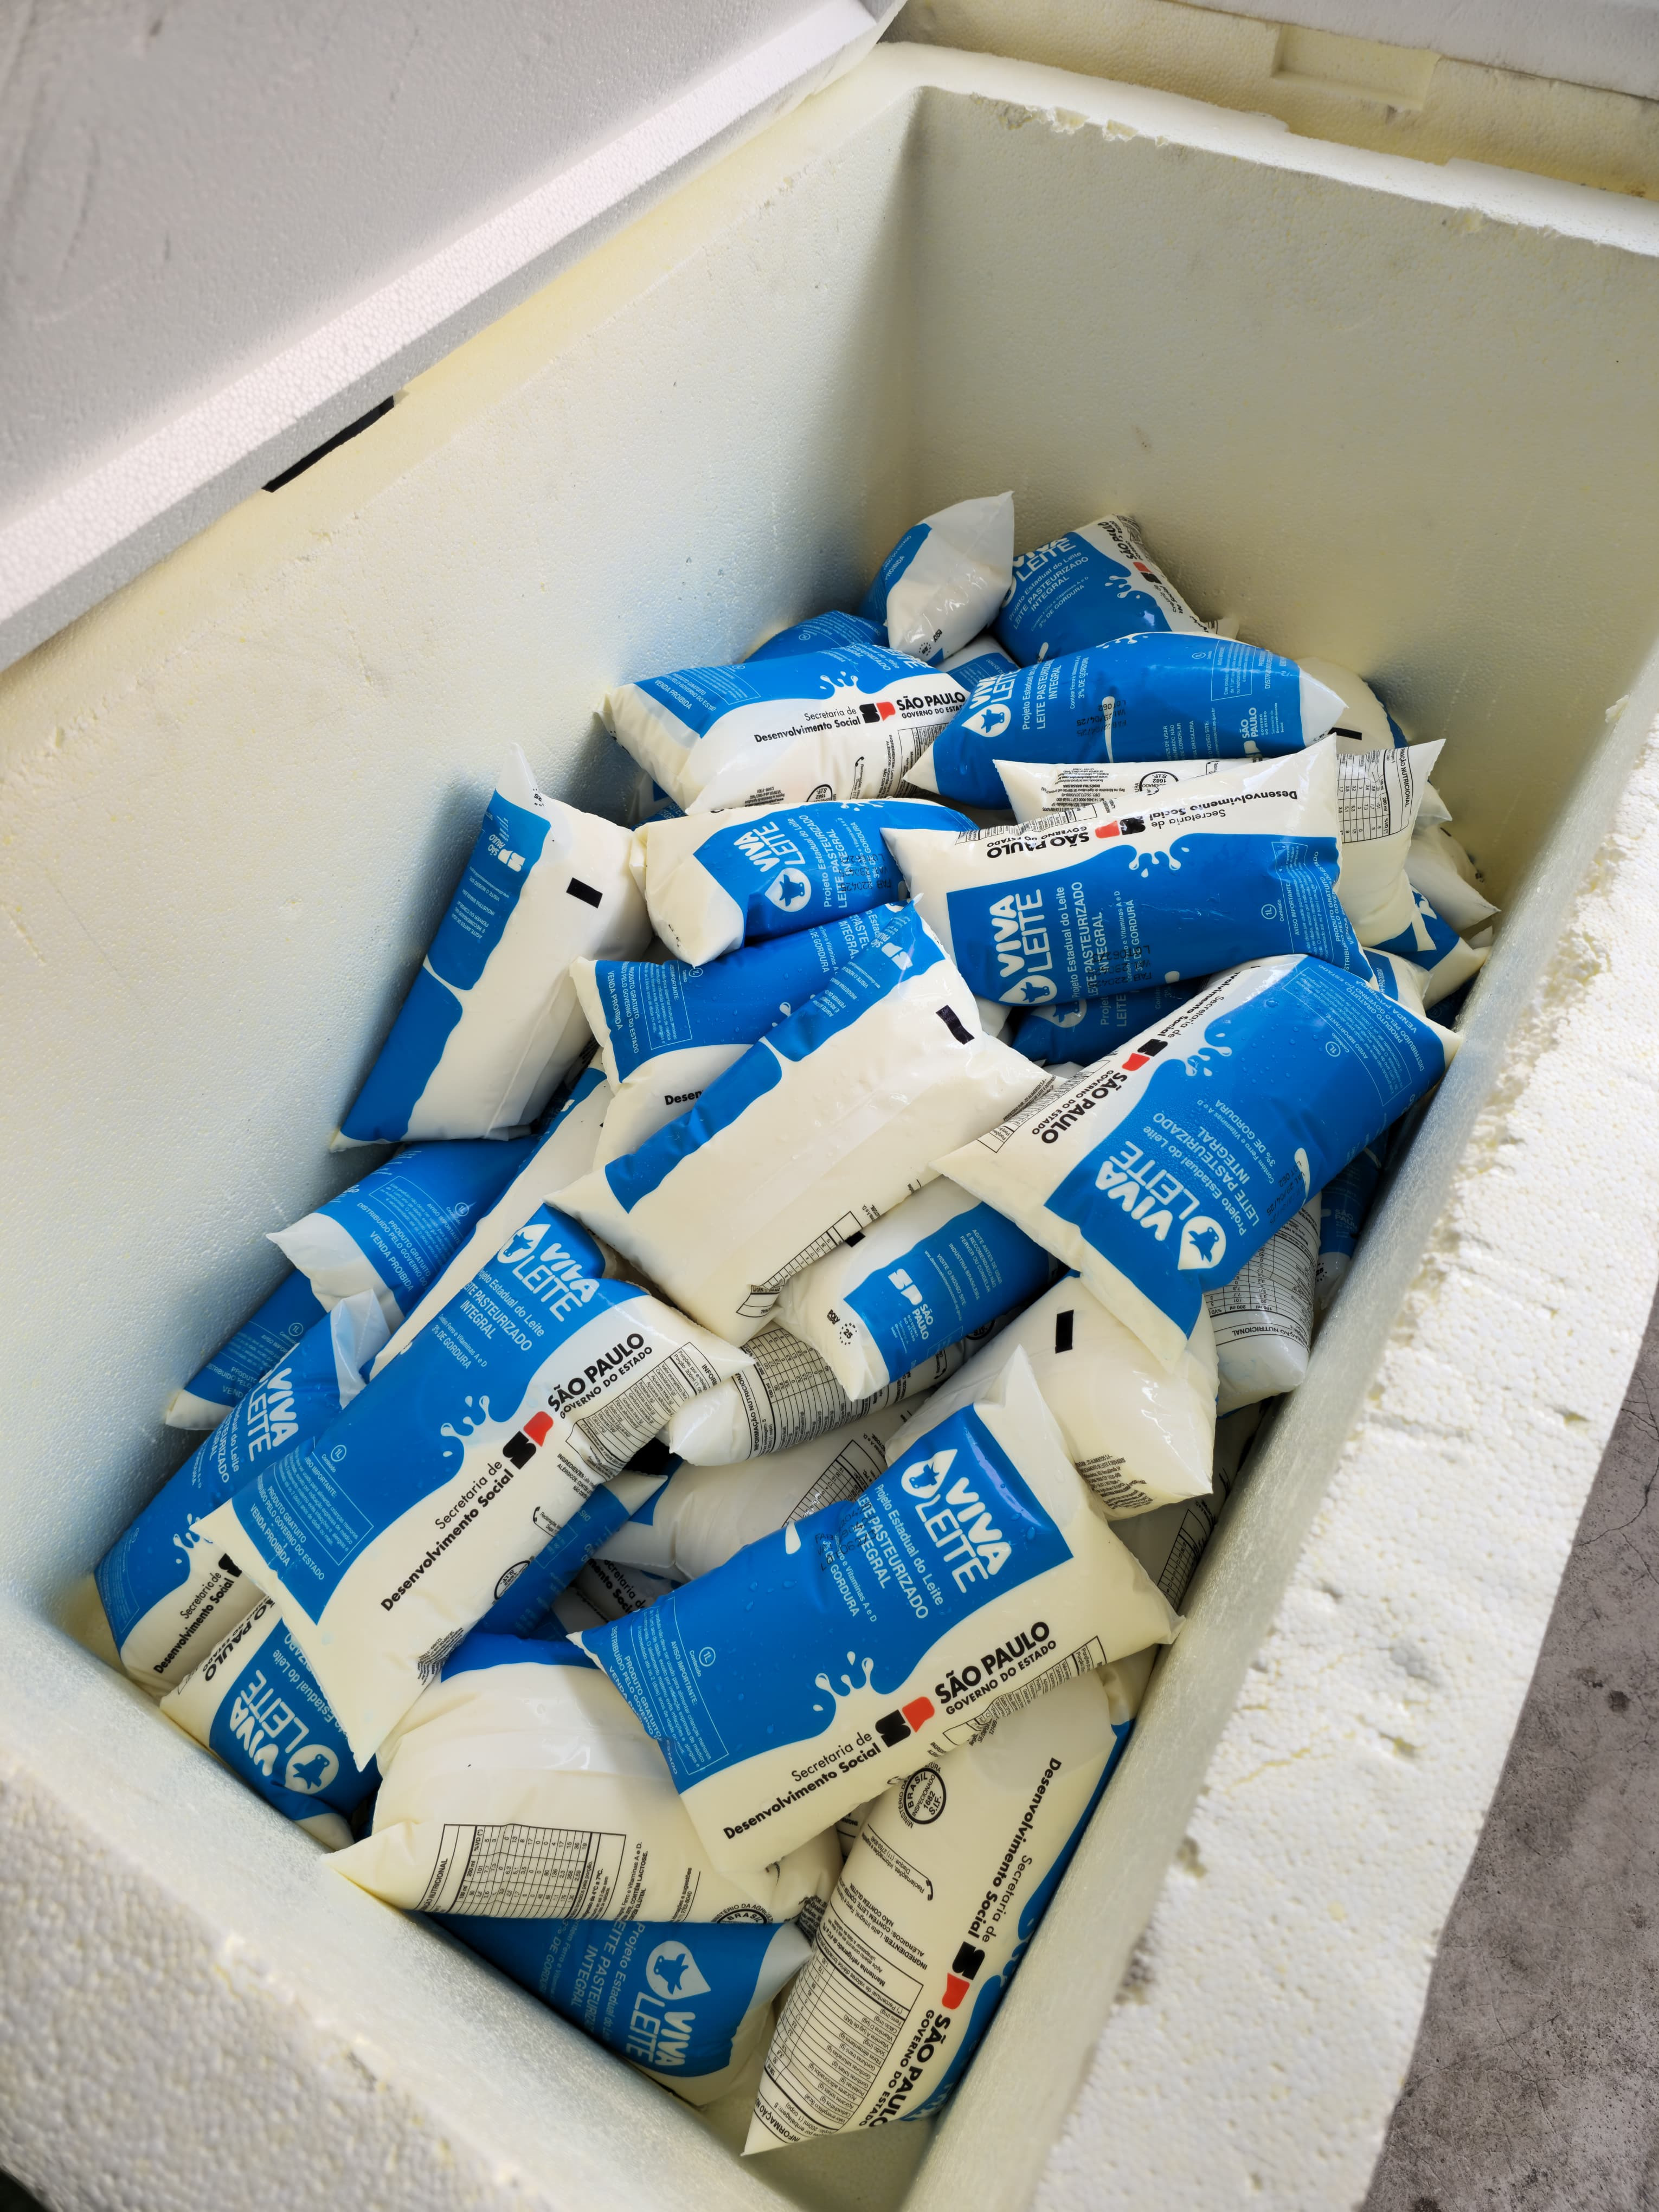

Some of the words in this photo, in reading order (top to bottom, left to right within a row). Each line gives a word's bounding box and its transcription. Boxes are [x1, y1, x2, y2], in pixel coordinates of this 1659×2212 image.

[1015, 540, 1076, 582] LEITE
[1025, 567, 1053, 596] Estadual
[1028, 556, 1089, 606] PASTEURIZADO
[1031, 576, 1070, 612] INTEGRAL
[670, 689, 693, 710] PROIBIDA
[896, 695, 923, 711] SÃO
[927, 692, 965, 707] PAULO
[1048, 665, 1062, 700] INTEGRAL
[754, 723, 832, 743] Desenvolvimento
[834, 717, 861, 729] Social
[804, 709, 844, 722] Secretaria
[846, 707, 857, 715] de
[901, 710, 933, 719] GOVERNO
[1023, 700, 1031, 730] Projeto
[1036, 700, 1046, 730] LEITE
[1239, 719, 1249, 738] SÃO
[1249, 707, 1259, 738] PAULO
[1189, 790, 1297, 812] Desenvolvimento
[1400, 766, 1410, 808] NUTRICIONAL
[1151, 820, 1165, 829] de
[1168, 809, 1226, 826] Secretaria
[487, 844, 499, 857] SÃO
[488, 833, 506, 850] PAULO
[734, 831, 780, 872] VIVA
[752, 821, 806, 865] LEITE
[799, 815, 841, 875] PASTEURIZADO
[806, 837, 826, 870] Estadual
[1050, 832, 1090, 848] SÃO
[822, 872, 832, 908] Projeto
[1056, 886, 1068, 910] Leite
[989, 895, 1025, 978] VIVA
[1015, 889, 1053, 973] LEITE
[1061, 912, 1070, 926] do
[1071, 882, 1096, 969] PASTEURIZADO
[1126, 899, 1140, 946] GORDURA
[813, 937, 831, 974] GORDURA
[1064, 927, 1077, 973] Estadual
[629, 988, 640, 1020] GRATUITO
[1071, 974, 1081, 998] Projeto
[1346, 988, 1378, 1015] GRATUITO
[610, 994, 623, 1031] PROIBIDA
[1157, 1015, 1188, 1037] Social
[1180, 996, 1225, 1028] Secretaria
[1376, 1013, 1403, 1044] PRODUTO
[1392, 1009, 1417, 1034] VENDA
[628, 1027, 640, 1054] ESTADO
[1167, 1030, 1182, 1038] de
[1329, 1045, 1338, 1054] 1L
[1062, 1098, 1076, 1109] DO
[1075, 1070, 1114, 1098] GOVERNO
[1091, 1072, 1128, 1099] SÃO
[1031, 1108, 1063, 1135] ESTADO
[1041, 1098, 1096, 1143] PAULO
[1142, 1125, 1167, 1148] Leite
[1215, 1099, 1256, 1141] GORDURA
[1152, 1112, 1238, 1192] PASTEURIZADO
[1168, 1145, 1182, 1158] do
[1197, 1126, 1250, 1185] INTEGRAL
[1253, 1139, 1267, 1154] DE
[1265, 1152, 1276, 1167] 3%
[1109, 1140, 1200, 1220] LEITE
[1180, 1155, 1223, 1200] Estadual
[1095, 1160, 1173, 1241] VIVA
[1221, 1197, 1246, 1236] Projeto
[1234, 1189, 1260, 1226] LEITE
[369, 1231, 391, 1258] VENDA
[388, 1256, 414, 1293] PROIBIDA
[388, 1220, 413, 1249] PRODUTO
[409, 1247, 430, 1277] GRATUITO
[937, 1253, 949, 1271] VISITE
[959, 1235, 975, 1257] FERVER
[976, 1263, 991, 1294] CONGELAR
[512, 1255, 583, 1322] LEITE
[540, 1243, 600, 1303] VIVA
[948, 1243, 966, 1271] INDÚSTRIA
[963, 1270, 980, 1301] BRASILEIRA
[459, 1298, 497, 1340] INTEGRAL
[474, 1289, 533, 1352] PASTEURIZADO
[488, 1278, 518, 1309] Estadual
[514, 1303, 527, 1319] do
[523, 1313, 545, 1337] Leite
[827, 1308, 841, 1323] POLY
[911, 1308, 929, 1340] PAULO
[919, 1303, 934, 1326] SÃO
[843, 1328, 853, 1340] 25
[1231, 1327, 1279, 1336] NUTRICIONAL
[442, 1336, 472, 1369] GORDURA
[548, 1377, 586, 1412] SÃO
[583, 1333, 645, 1384] PAULO
[560, 1386, 602, 1420] GOVERNO
[602, 1374, 618, 1388] DO
[619, 1346, 653, 1376] ESTADO
[247, 1379, 272, 1462] LEITE
[267, 1367, 299, 1448] VIVA
[750, 1411, 760, 1451] INFORMAÇÃO
[435, 1475, 488, 1530] Secretaria
[487, 1460, 503, 1476] de
[267, 1486, 285, 1515] PRODUTO
[283, 1512, 307, 1544] GRATUITO
[945, 1476, 1012, 1576] VIVA
[249, 1503, 267, 1532] VENDA
[264, 1529, 291, 1567] PROIBIDA
[274, 1516, 297, 1546] GOVERNO
[301, 1554, 325, 1580] ESTADO
[381, 1508, 479, 1612] Desenvolvimento
[478, 1468, 515, 1508] Social
[874, 1483, 893, 1511] Projeto
[888, 1508, 920, 1558] Estadual
[913, 1556, 927, 1574] do
[922, 1573, 945, 1606] Leite
[915, 1493, 989, 1594] LEITE
[845, 1564, 866, 1603] Vitaminas
[869, 1517, 929, 1619] PASTEURIZADO
[179, 1580, 215, 1620] Secretaria
[829, 1563, 861, 1617] GORDURA
[153, 1604, 214, 1674] Desenvolvimento
[209, 1577, 235, 1604] Social
[273, 1649, 291, 1674] Leite
[288, 1668, 301, 1684] do
[624, 1655, 644, 1695] PRODUTO
[670, 1641, 680, 1660] AVISO
[676, 1658, 698, 1707] IMPORTANTE:
[689, 1649, 702, 1678] Conteúdo
[935, 1665, 982, 1705] SÃO
[980, 1621, 1050, 1676] PAULO
[946, 1679, 999, 1716] GOVERNO
[999, 1666, 1017, 1683] DO
[1018, 1639, 1057, 1671] ESTADO
[240, 1669, 310, 1754] LEITE
[229, 1696, 279, 1777] VIVA
[791, 1742, 854, 1783] Secretaria
[856, 1731, 873, 1747] de
[723, 1771, 839, 1840] Desenvolvimento
[838, 1741, 882, 1774] Social
[906, 1771, 929, 1809] BRASIL
[911, 1773, 936, 1818] INSPECIONADO
[922, 1790, 936, 1811] 1682
[928, 1795, 942, 1816] S.I.F.
[991, 1757, 1063, 1889] Desenvolvimento
[428, 1857, 449, 1900] NUTRICIONAL
[991, 1853, 1033, 1925] Secretaria
[967, 1889, 999, 1939] Social
[619, 1924, 646, 1969] Projeto
[883, 1934, 928, 1971] INGREDIENTES:
[981, 1924, 998, 1944] de
[626, 1990, 666, 2062] LEITE
[899, 2009, 935, 2068] GOVERNO
[916, 2012, 951, 2063] SÃO
[887, 2070, 903, 2089] DO
[758, 2104, 801, 2143] INFORMAÇÃO
[858, 2090, 890, 2127] ESTADO
